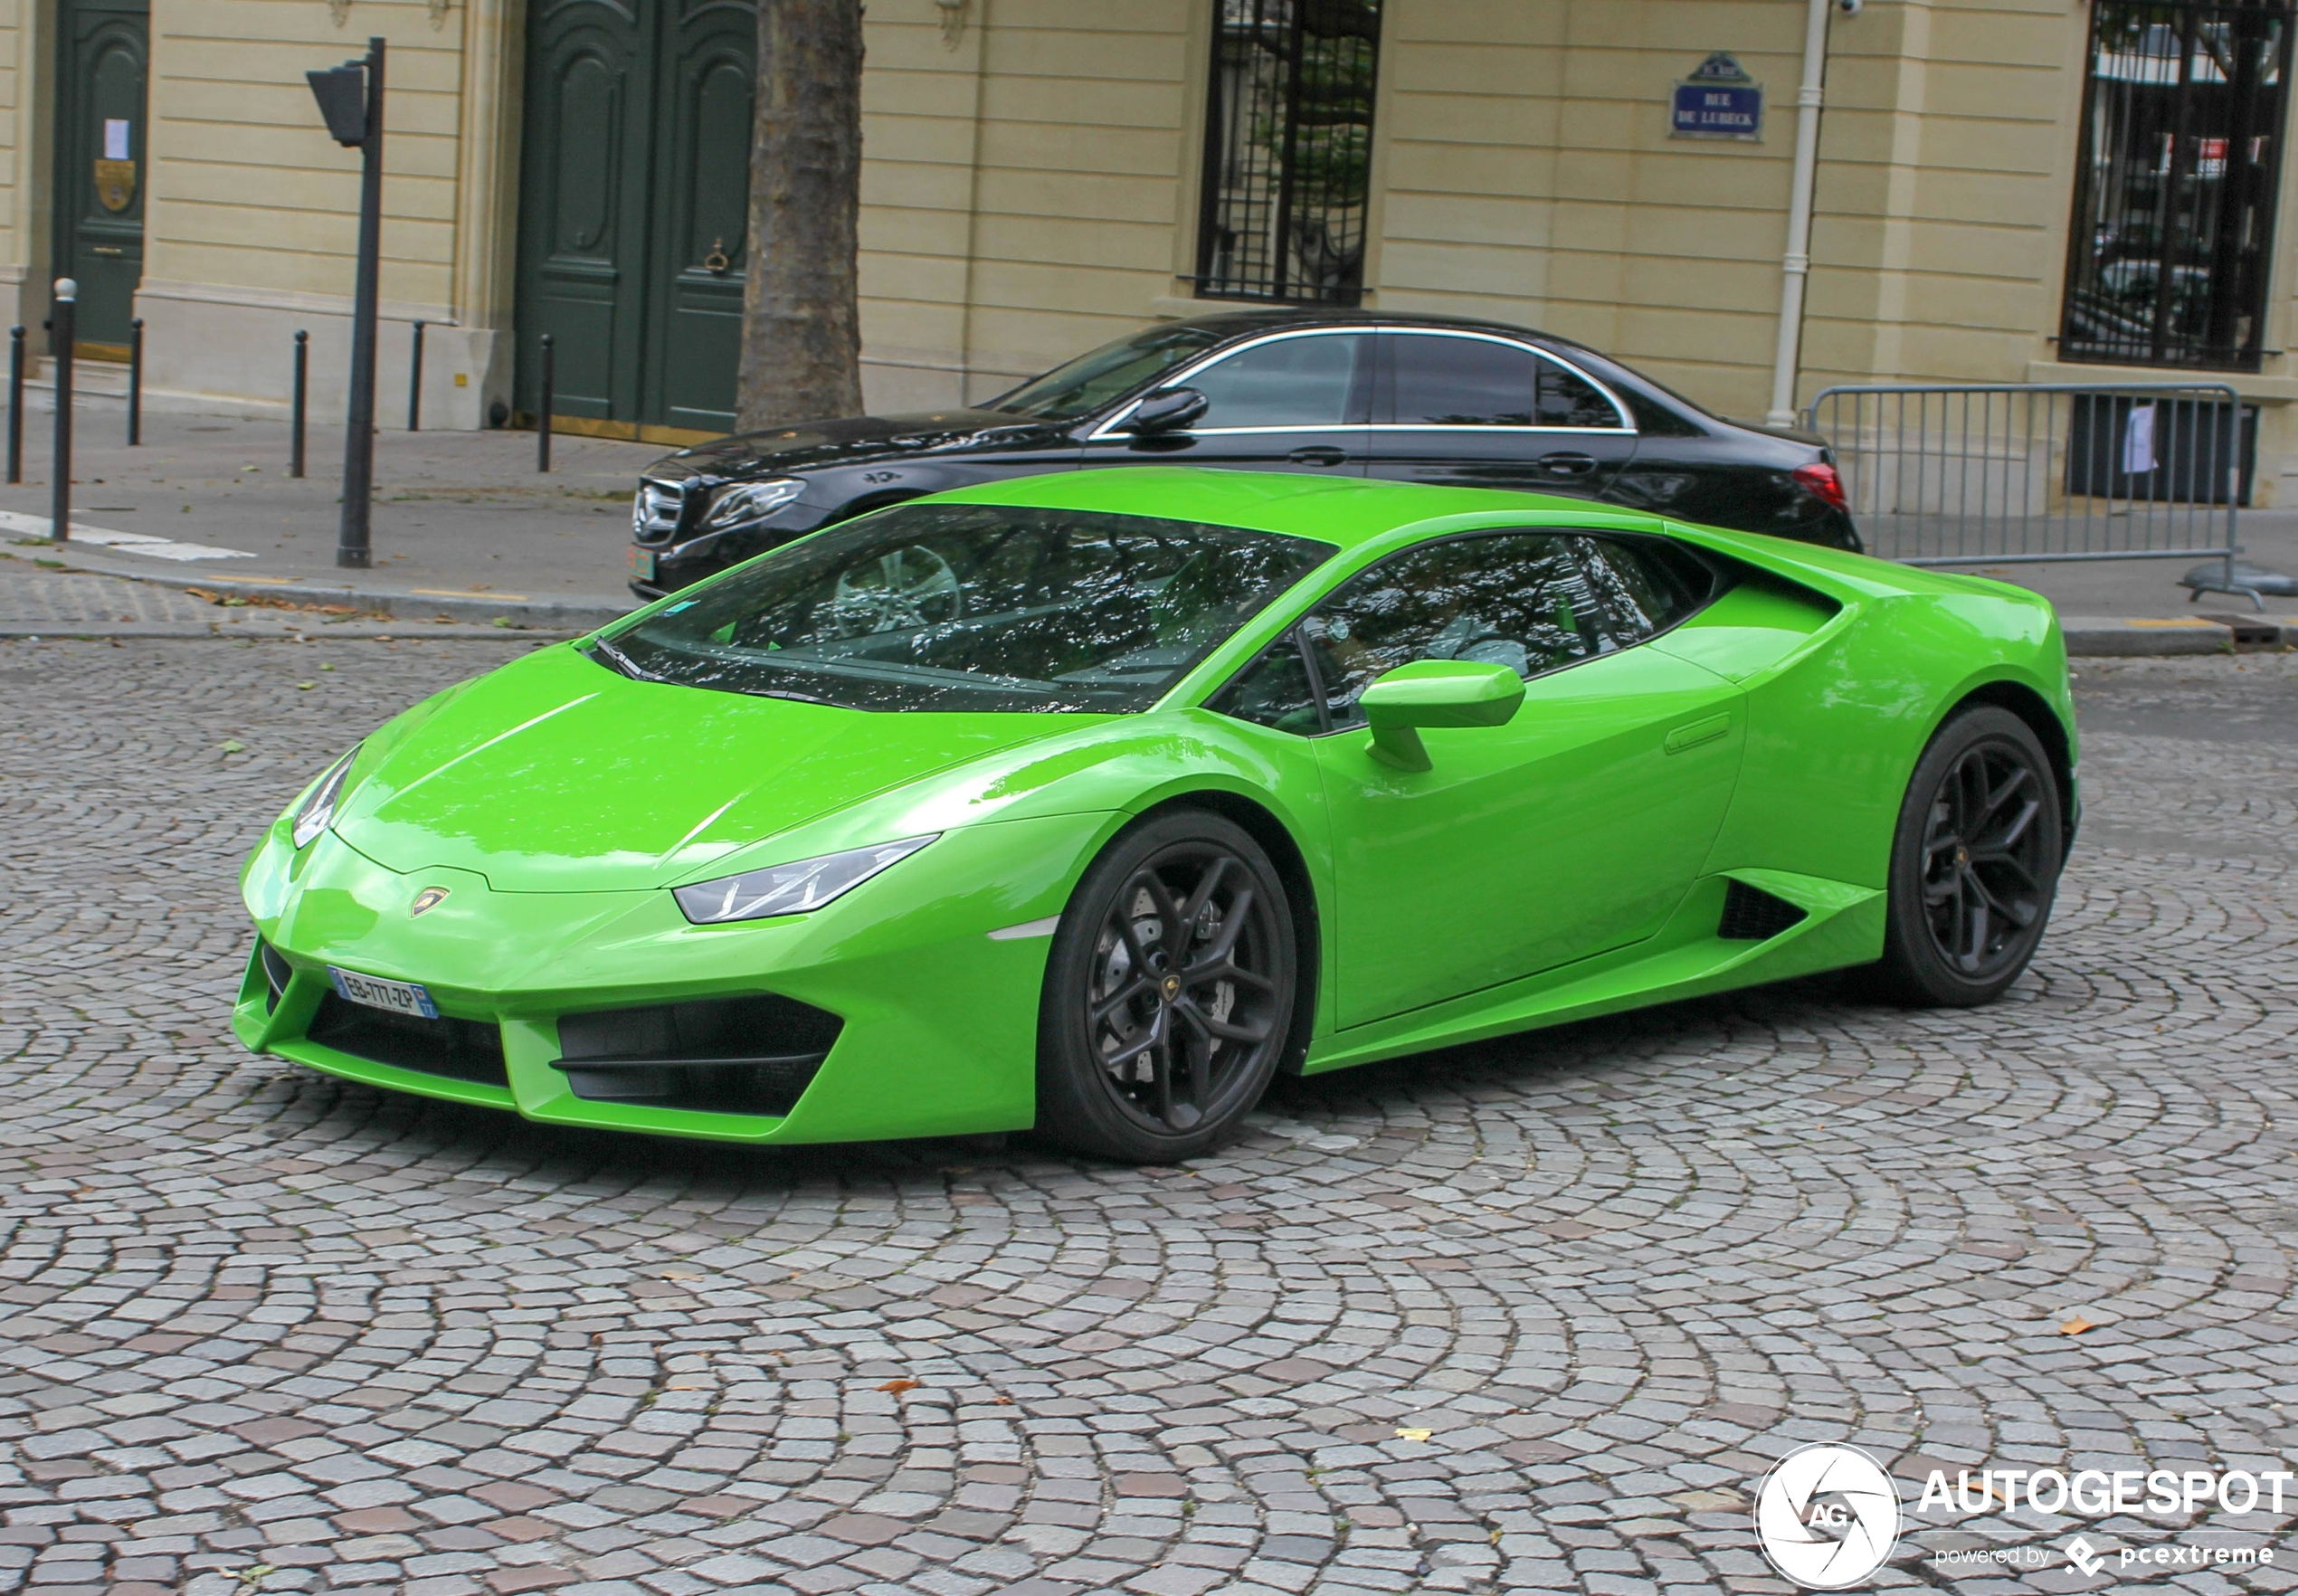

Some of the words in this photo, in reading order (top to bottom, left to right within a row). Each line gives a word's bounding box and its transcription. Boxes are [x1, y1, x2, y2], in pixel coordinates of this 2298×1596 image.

[1705, 92, 1731, 106] RUE
[1677, 109, 1696, 123] DE
[1701, 110, 1752, 126] LUBECK
[344, 976, 413, 1009] EB-777-ZP
[421, 1002, 433, 1015] 77
